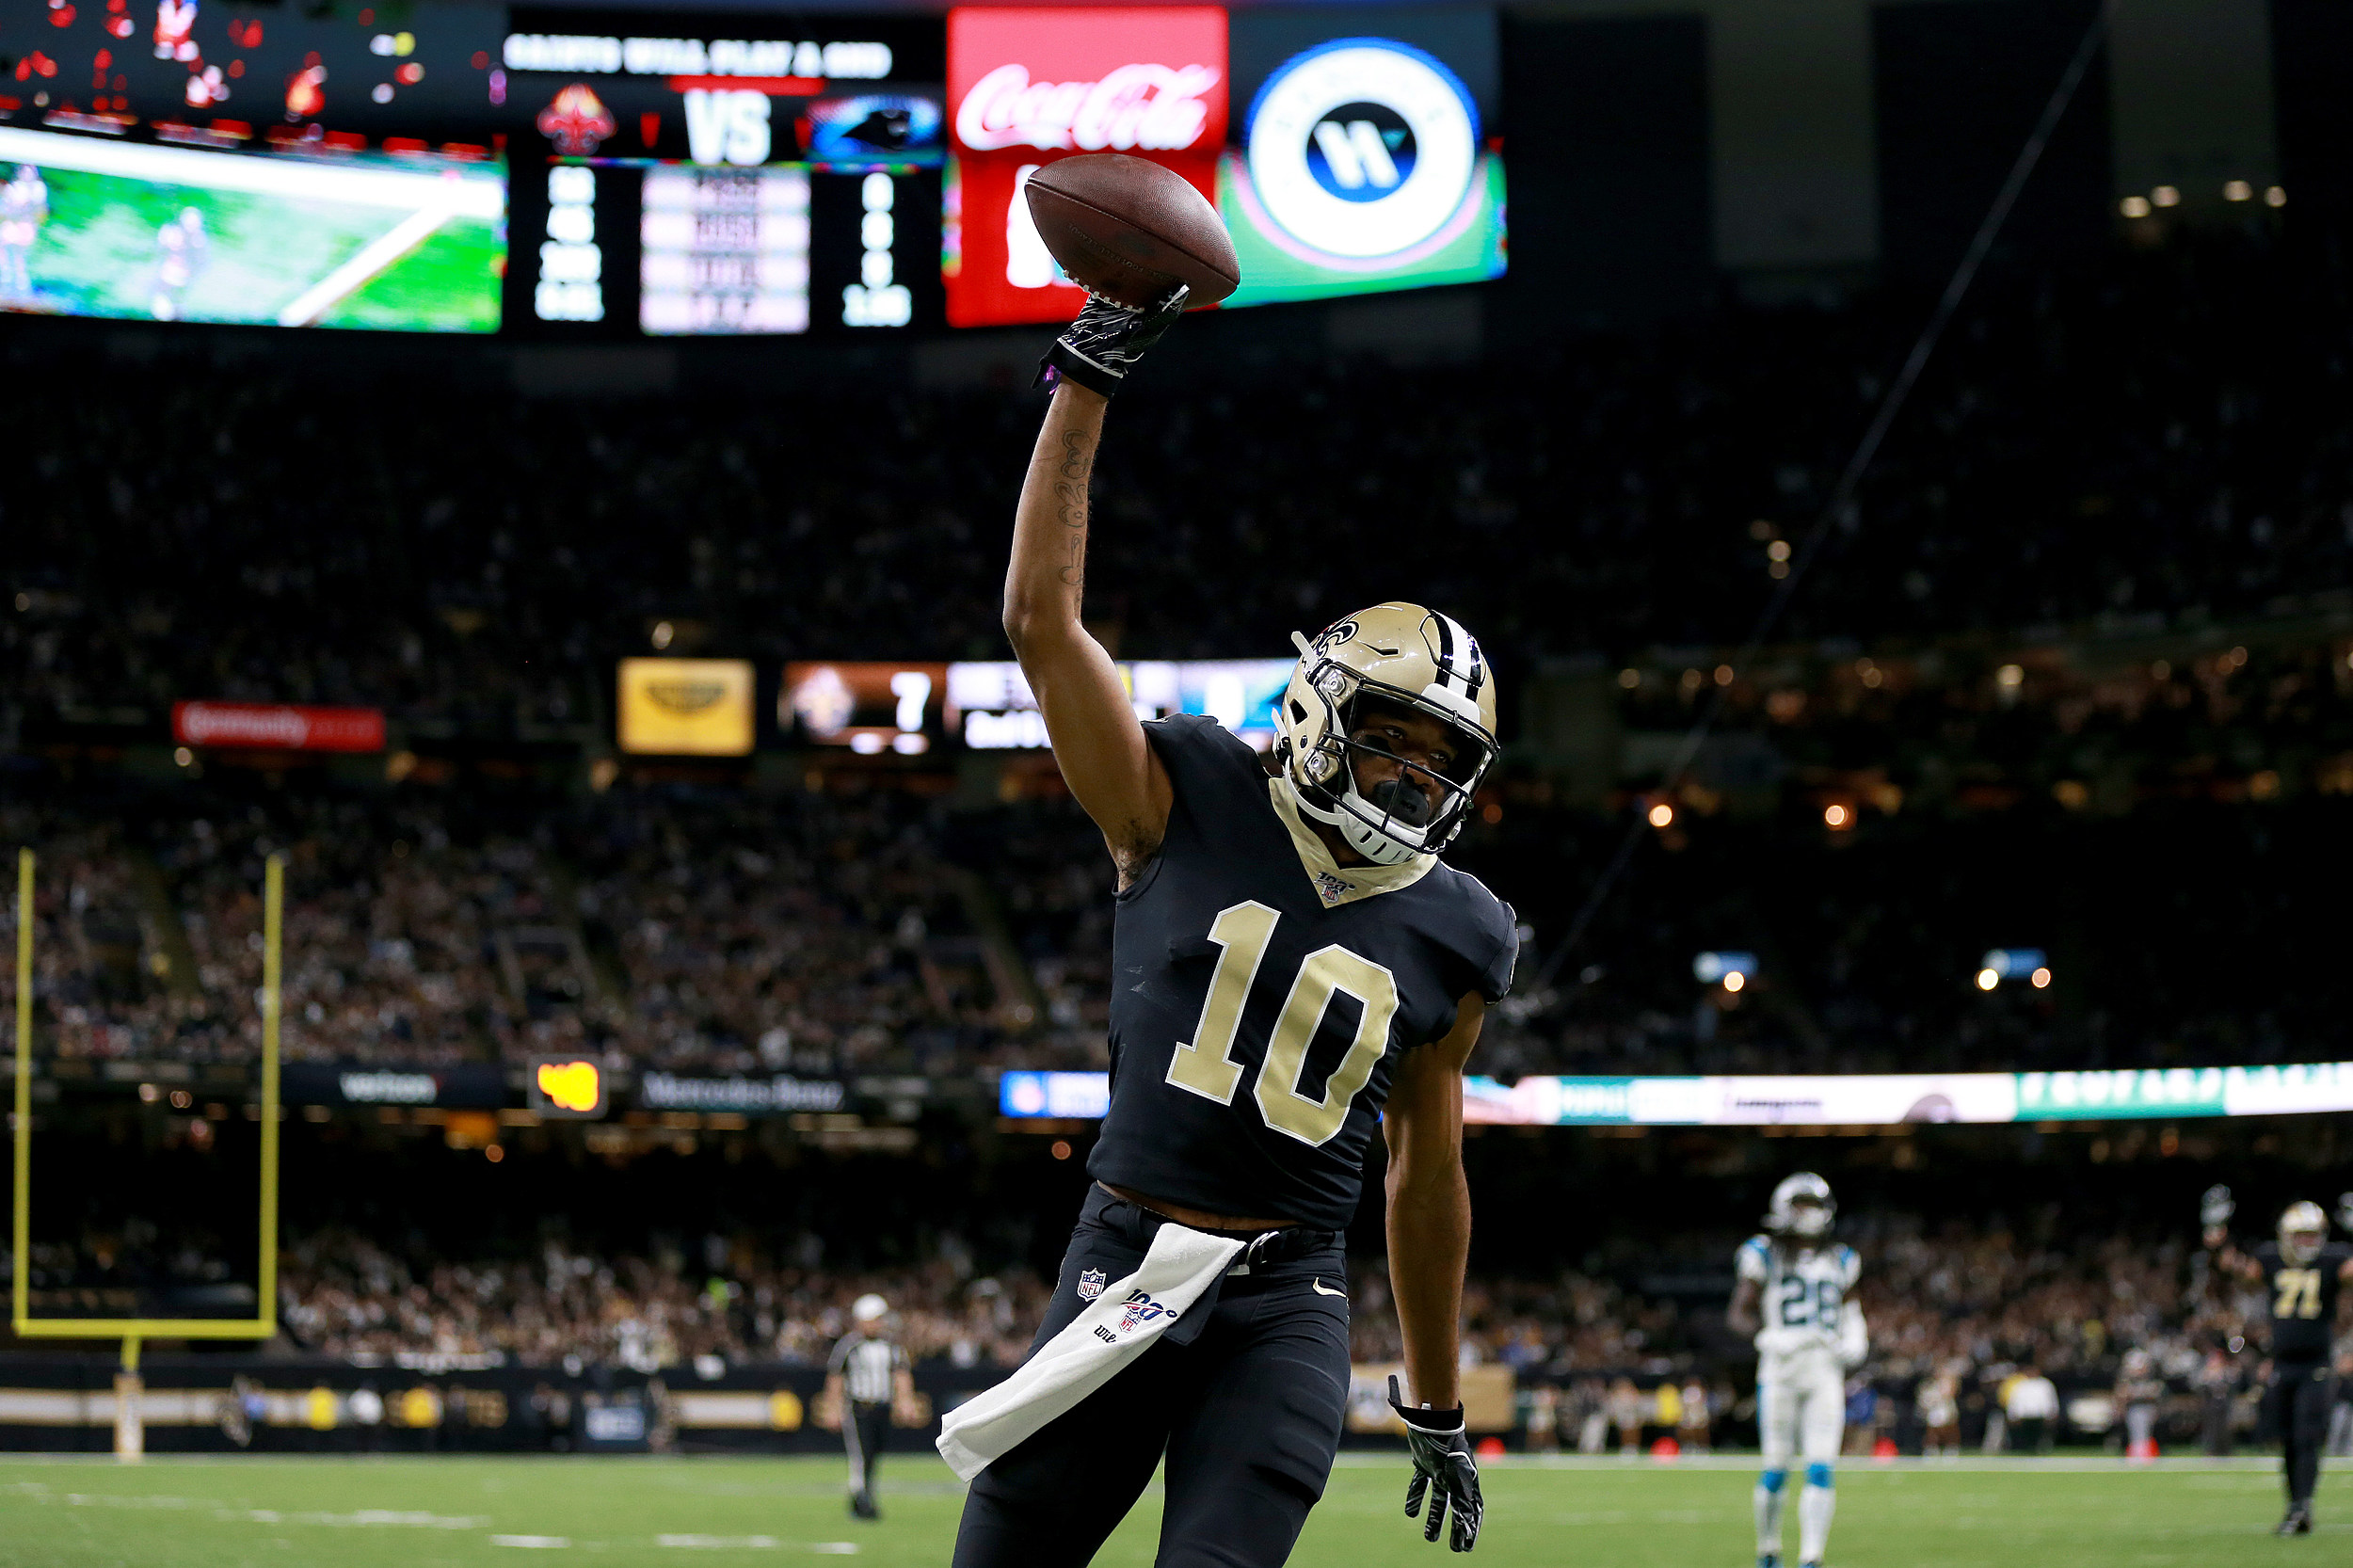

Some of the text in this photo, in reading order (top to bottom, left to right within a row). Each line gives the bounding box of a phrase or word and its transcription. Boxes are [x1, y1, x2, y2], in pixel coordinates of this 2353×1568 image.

[684, 88, 772, 166] VS
[1165, 899, 1401, 1147] 10
[1081, 1283, 1098, 1296] NFL
[2273, 1268, 2323, 1320] 71
[1094, 1324, 1117, 1344] Wil
[1120, 1318, 1135, 1332] NFL
